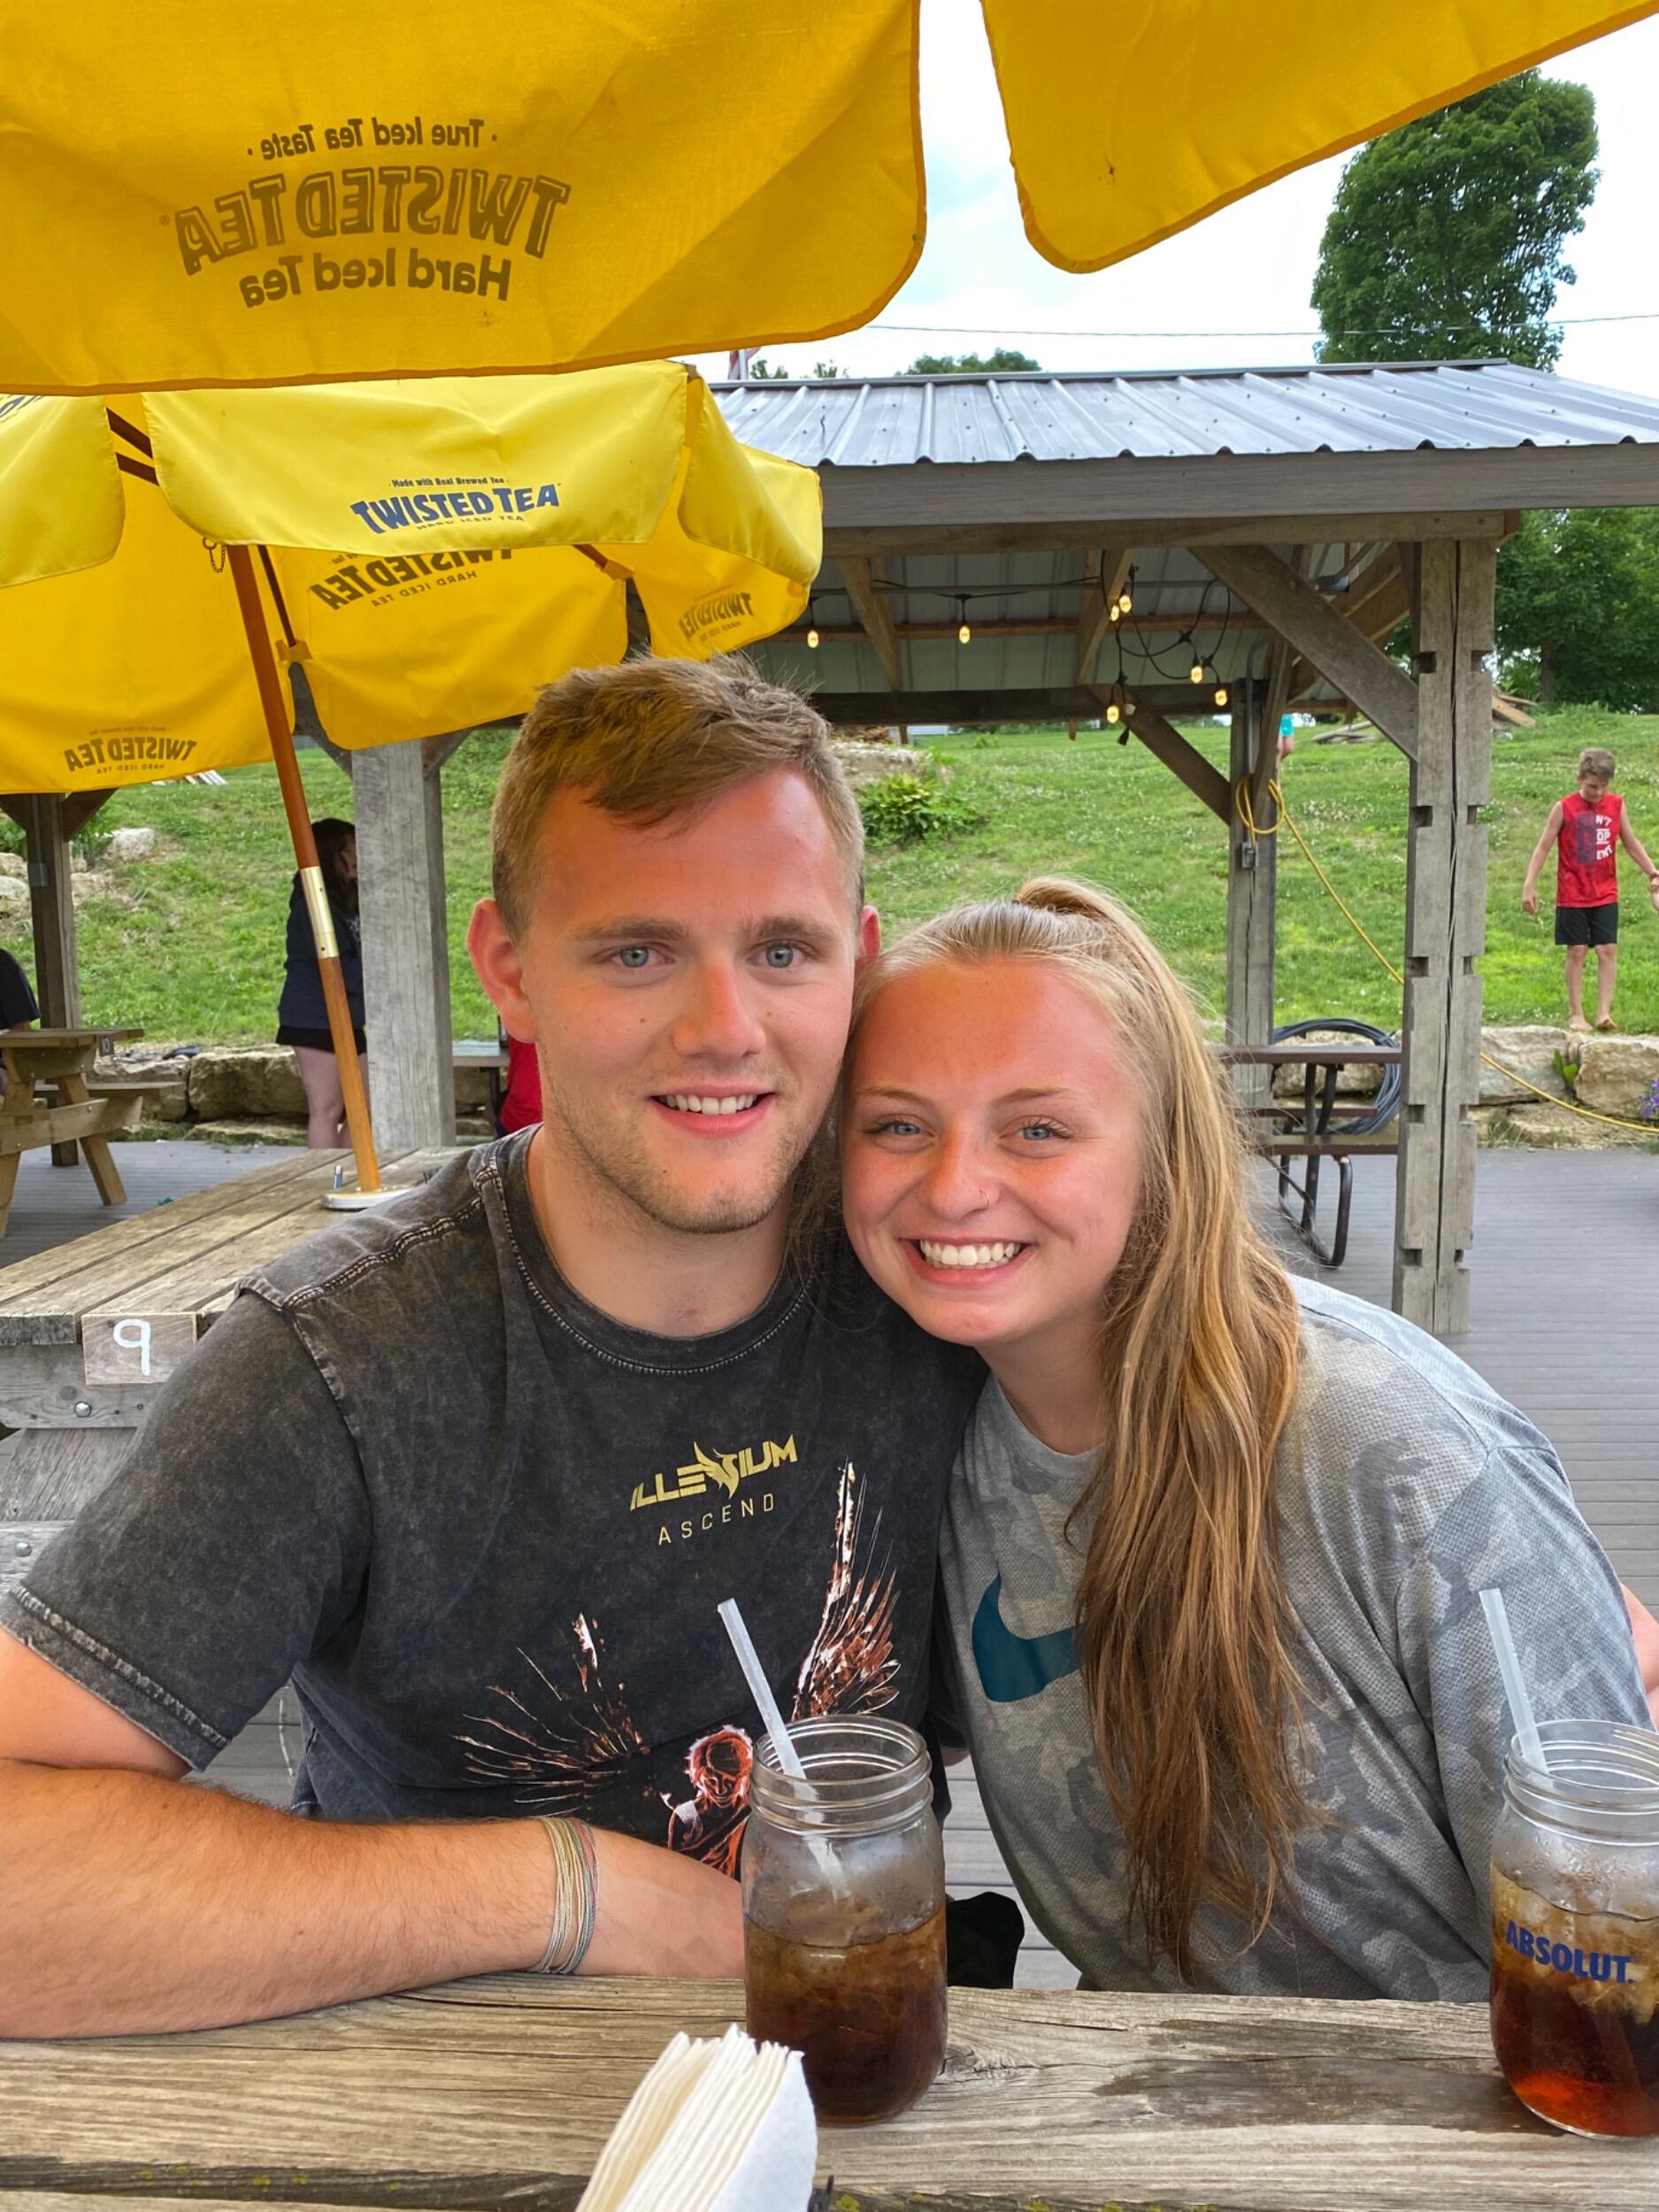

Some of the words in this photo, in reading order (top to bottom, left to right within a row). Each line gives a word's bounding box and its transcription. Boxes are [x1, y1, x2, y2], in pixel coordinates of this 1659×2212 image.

[392, 478, 414, 488] Made
[416, 477, 434, 486] with
[436, 477, 454, 486] Real
[456, 476, 488, 485] Brewed
[350, 492, 495, 534] TWISTED
[492, 484, 560, 514] TEA
[112, 1318, 151, 1377] 9
[658, 1493, 774, 1546] ASCEND
